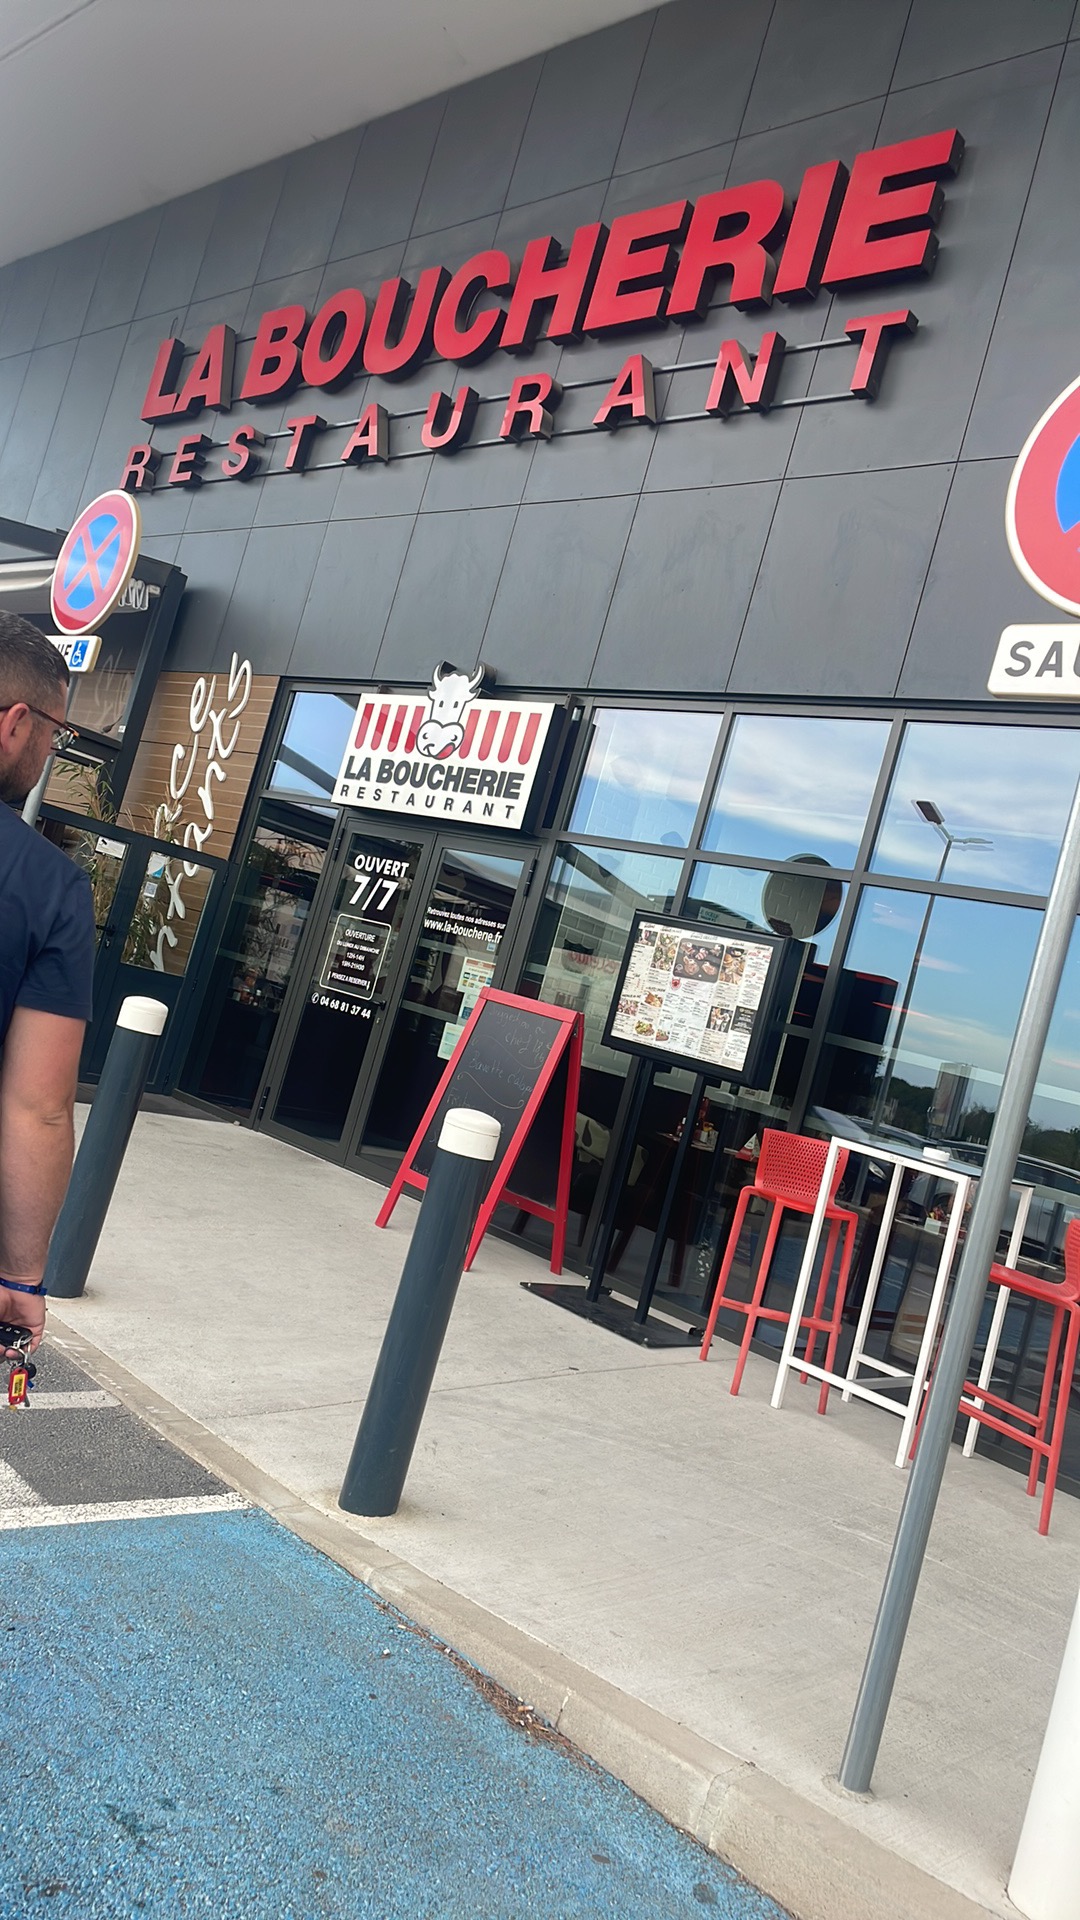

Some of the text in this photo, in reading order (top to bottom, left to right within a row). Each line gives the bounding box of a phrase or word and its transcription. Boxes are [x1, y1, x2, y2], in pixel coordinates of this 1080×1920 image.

[141, 128, 961, 421] LA BOUCHERIE
[120, 309, 913, 490] RESTAURANT
[1004, 639, 1080, 678] SA
[343, 755, 525, 799] LA BOUCHERIE
[340, 784, 515, 820] RESTAURANT
[354, 853, 410, 878] OUVERT
[349, 876, 400, 911] 7/7
[424, 918, 502, 944] www.la-boucherie.fr
[426, 906, 450, 918] Retrouvez
[450, 911, 465, 921] toutes
[475, 917, 497, 927] adresses
[497, 922, 507, 930] sur
[342, 941, 354, 949] LUNDI
[359, 944, 380, 954] DIMANCHE
[345, 928, 376, 943] OUVERTURE
[319, 995, 372, 1019] 04 68 81 37 44
